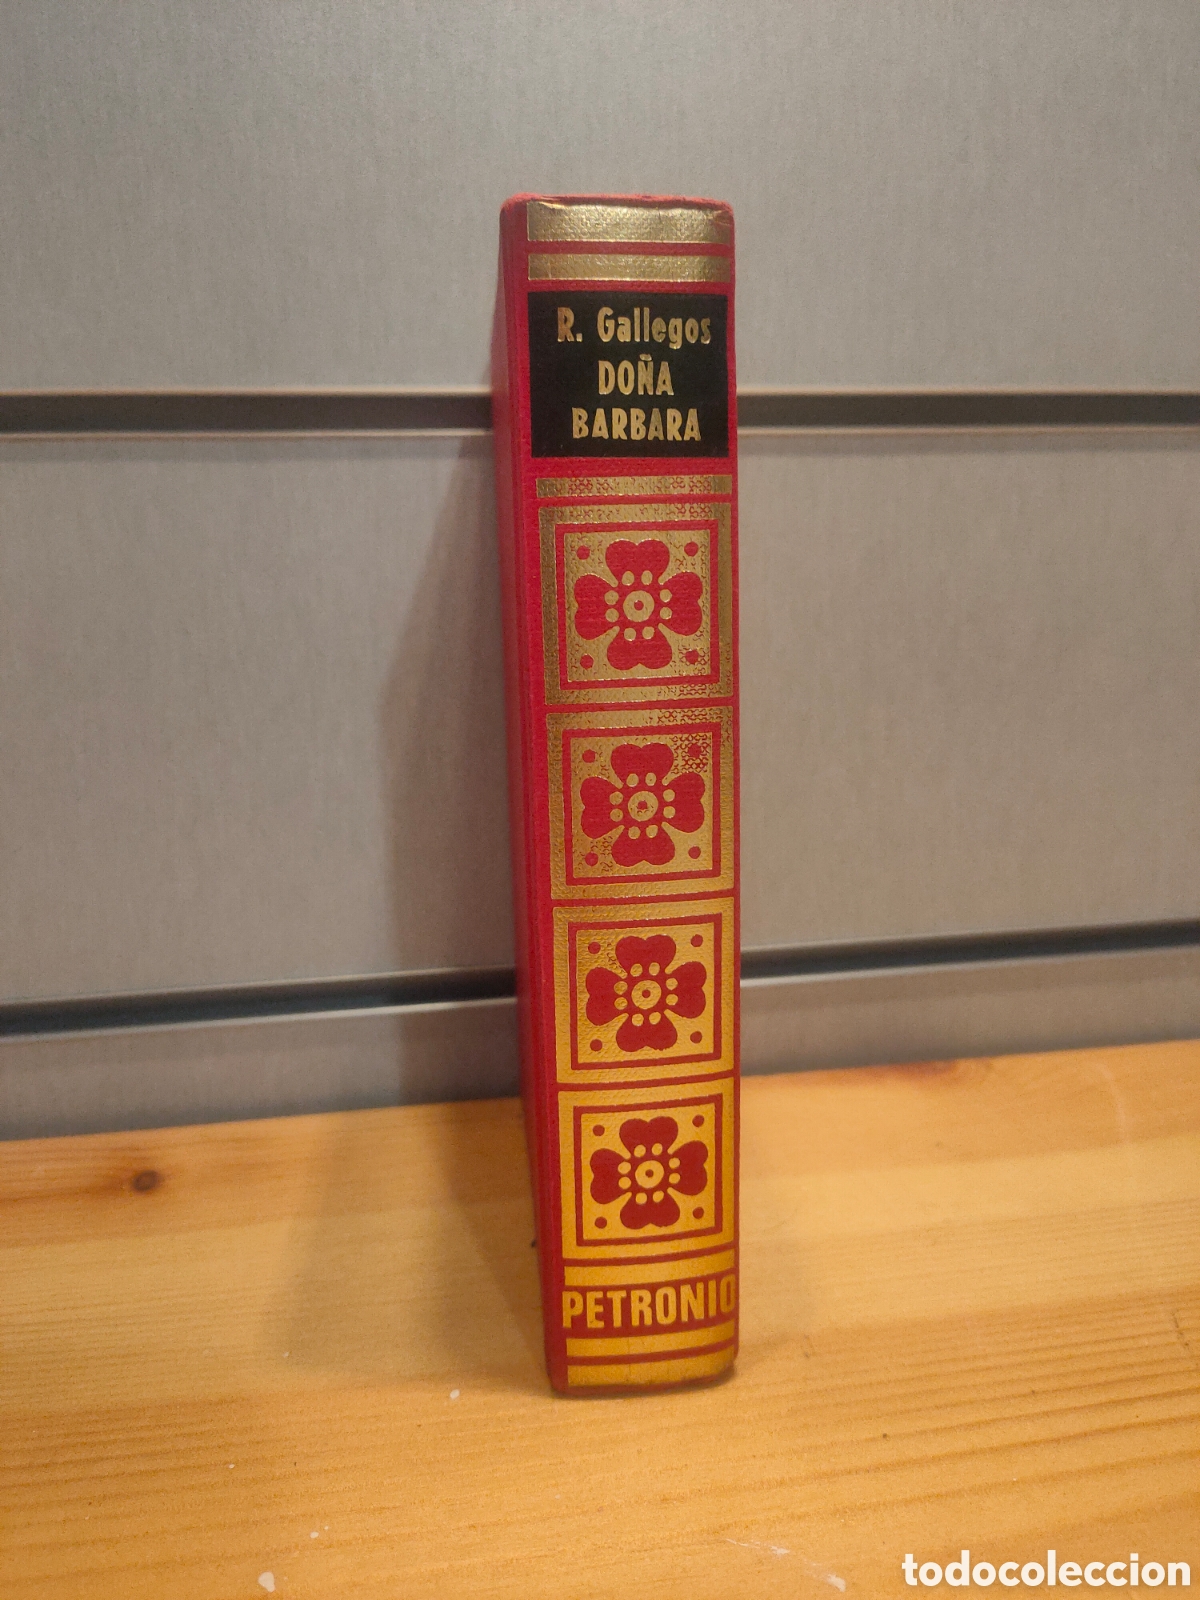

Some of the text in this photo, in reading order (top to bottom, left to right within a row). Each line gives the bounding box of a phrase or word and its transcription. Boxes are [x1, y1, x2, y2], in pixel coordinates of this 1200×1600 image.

[557, 307, 712, 350] R. Gallegos
[598, 354, 675, 396] DOÑA
[572, 407, 702, 441] BARBARA
[562, 1273, 736, 1329] PETRONIO
